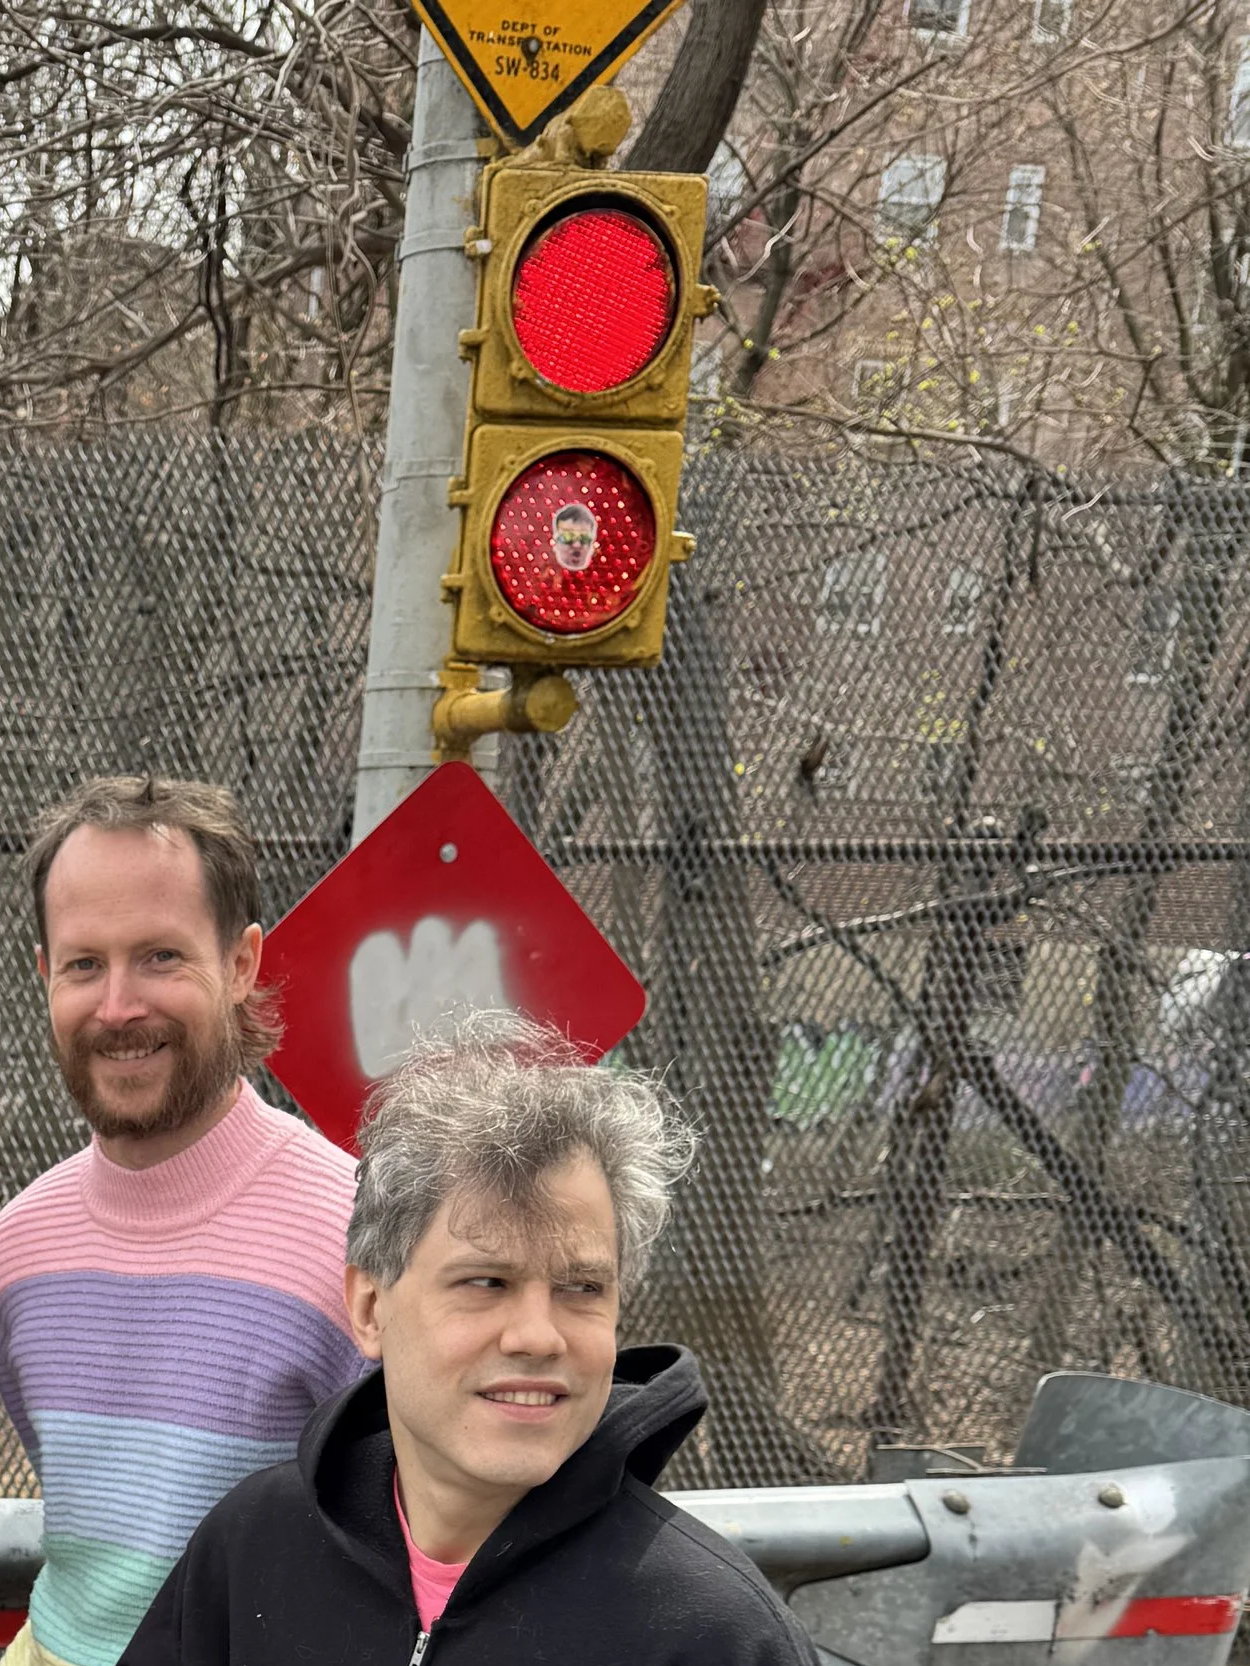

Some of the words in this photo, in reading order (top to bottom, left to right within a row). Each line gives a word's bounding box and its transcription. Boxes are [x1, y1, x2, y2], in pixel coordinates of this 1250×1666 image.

[501, 20, 537, 34] DEPT
[543, 26, 561, 36] OF
[468, 30, 592, 56] TRANSPTATION
[495, 56, 560, 83] SW-834
